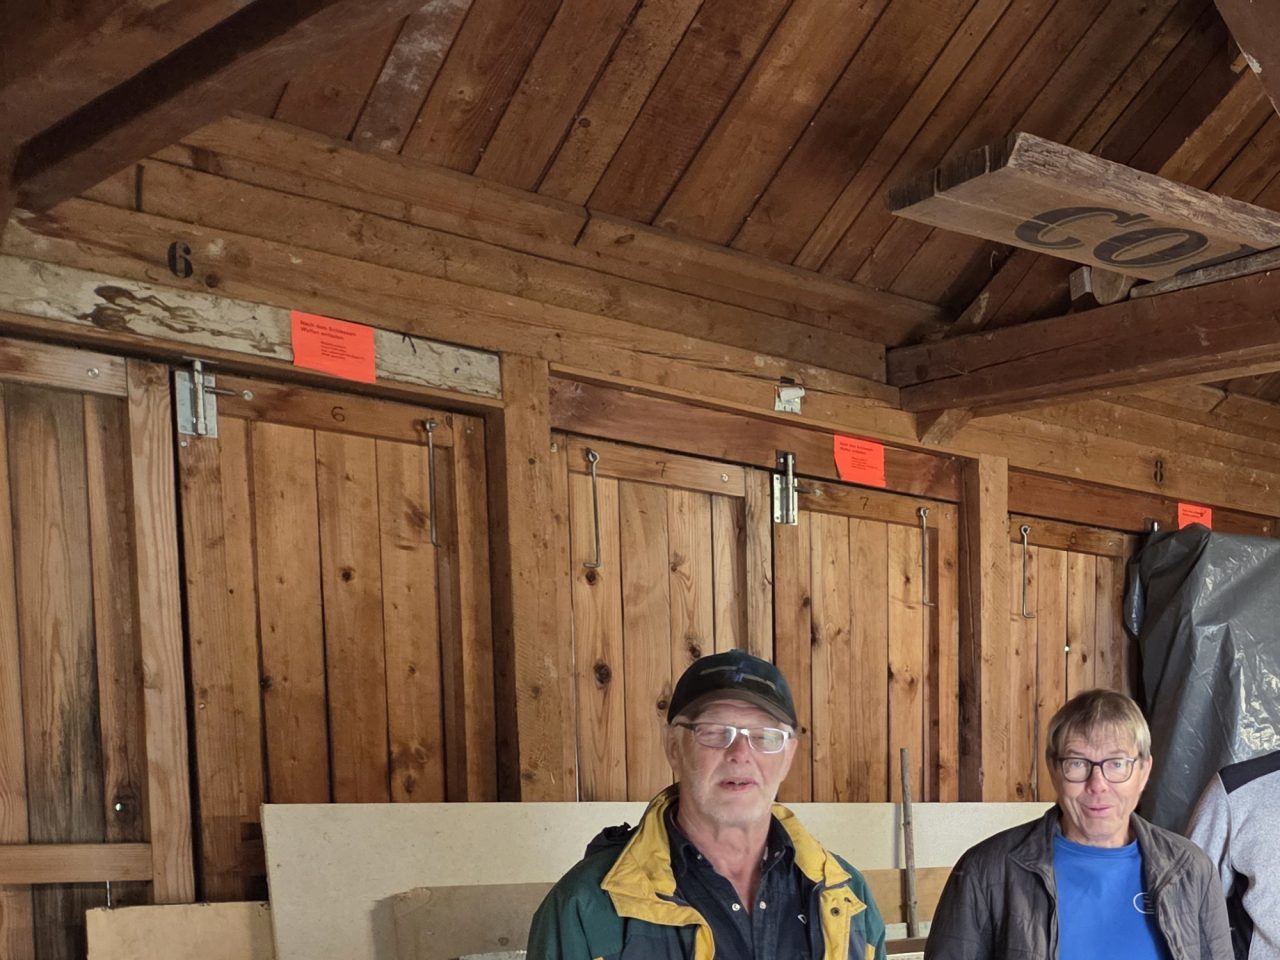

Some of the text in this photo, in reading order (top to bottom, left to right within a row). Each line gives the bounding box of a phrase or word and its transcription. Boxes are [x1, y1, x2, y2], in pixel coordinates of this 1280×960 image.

[167, 241, 194, 279] 6
[331, 406, 345, 422] 6
[655, 461, 667, 478] 7
[1153, 459, 1164, 484] 8
[859, 496, 870, 511] 7
